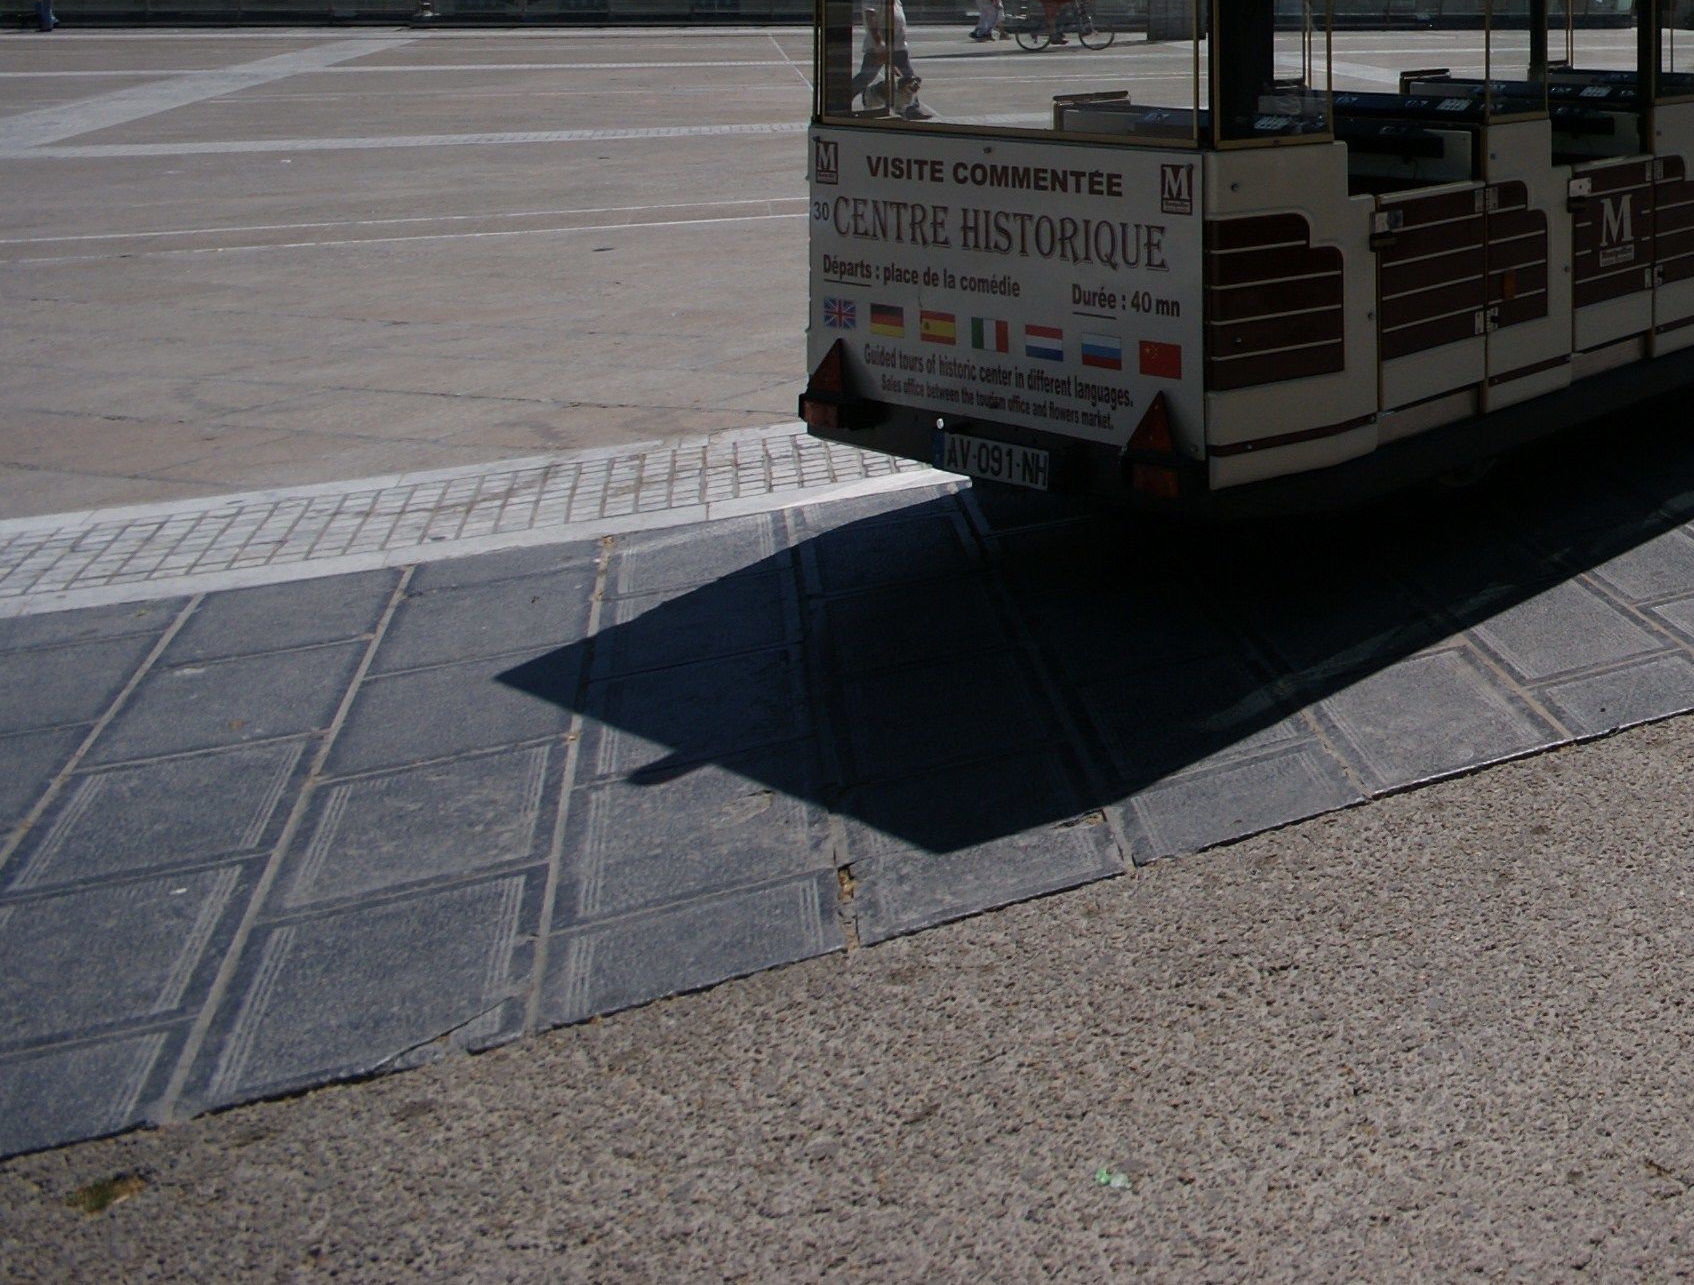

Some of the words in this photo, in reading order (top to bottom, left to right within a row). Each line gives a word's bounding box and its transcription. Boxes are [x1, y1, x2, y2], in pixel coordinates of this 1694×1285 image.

[818, 143, 837, 171] M
[866, 156, 944, 183] VISITE
[953, 162, 1123, 197] COMMENTÉE
[1163, 167, 1191, 200] M
[813, 201, 830, 221] 30
[834, 196, 951, 250] CENTRE
[960, 206, 1169, 271] HISTORIQUE
[1600, 194, 1634, 247] M
[823, 253, 872, 280] Départs
[883, 265, 919, 289] place
[923, 267, 940, 288] de
[943, 268, 957, 289] la
[960, 272, 1021, 298] comédie
[1072, 284, 1117, 309] Durée
[1131, 290, 1152, 313] 40
[1155, 299, 1181, 317] mn
[864, 343, 897, 368] Guided
[899, 350, 925, 373] tours
[926, 353, 936, 374] of
[938, 354, 977, 381] historic
[979, 364, 1013, 387] center
[1014, 367, 1025, 388] in
[1027, 369, 1072, 397] different
[1074, 375, 1134, 411] languages.
[881, 373, 902, 394] Sales
[903, 378, 925, 398] office
[926, 381, 960, 403] between
[961, 386, 975, 406] the
[1008, 394, 1030, 415] office
[1032, 400, 1047, 417] and
[1048, 400, 1080, 425] flowers
[1081, 410, 1115, 430] market.
